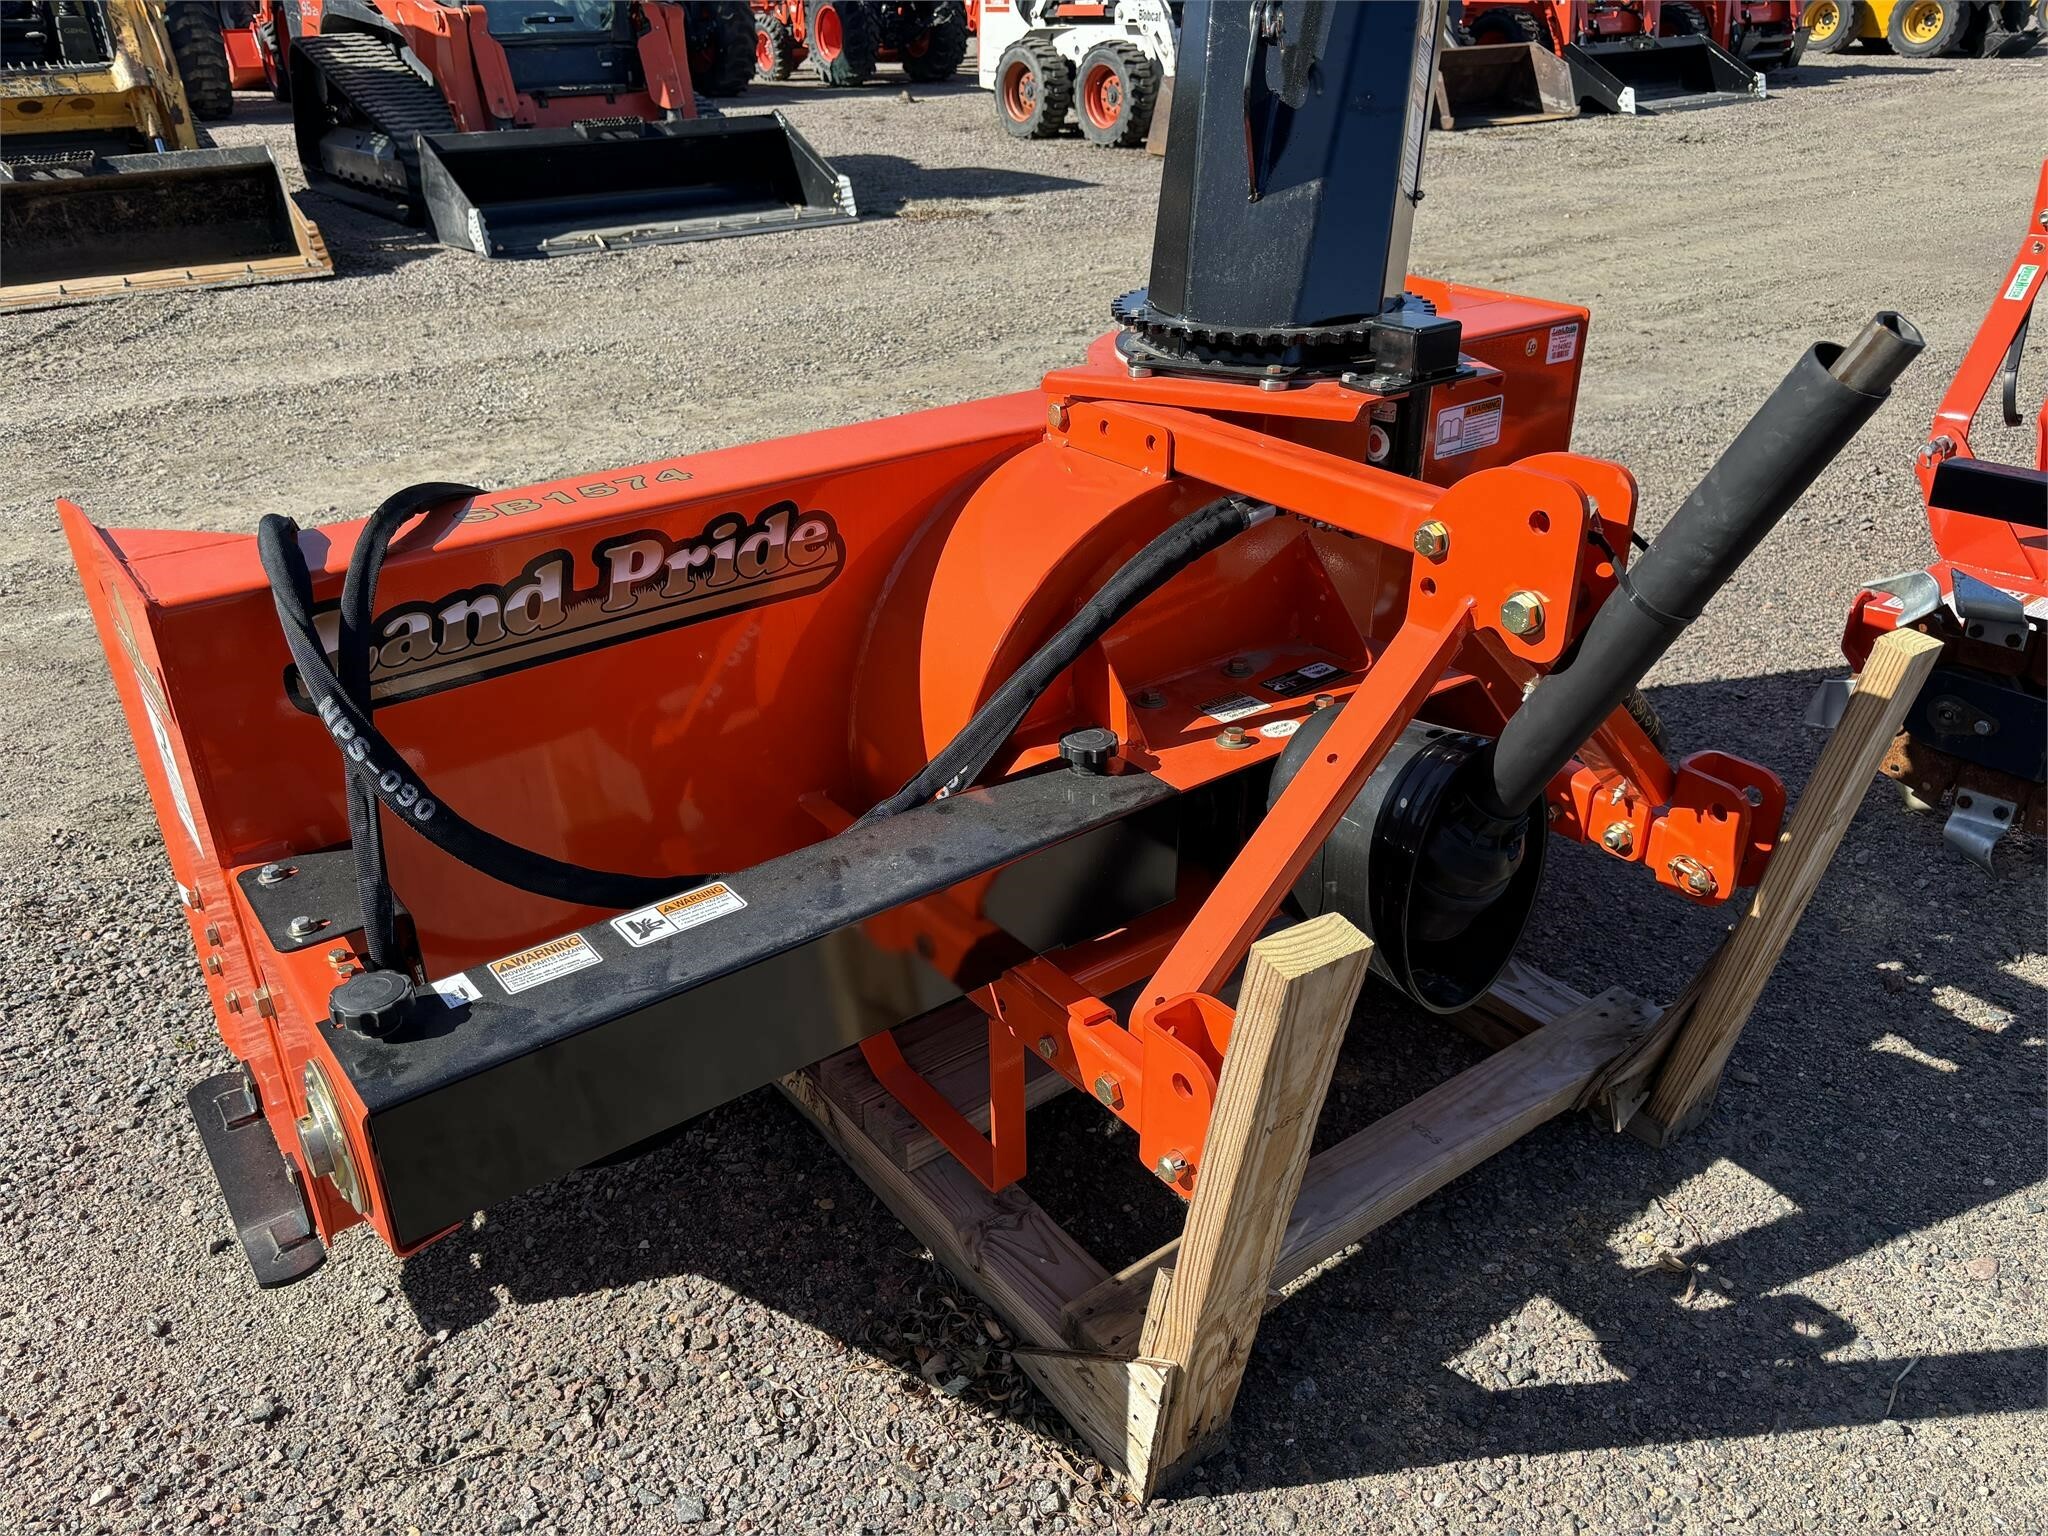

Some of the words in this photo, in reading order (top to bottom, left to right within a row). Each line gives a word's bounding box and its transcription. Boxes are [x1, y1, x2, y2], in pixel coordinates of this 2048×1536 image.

[1139, 9, 1161, 21] Bobcat
[453, 468, 693, 524] SB1574
[601, 510, 829, 613] Pride
[673, 886, 724, 907] WARNING
[501, 964, 532, 978] MOVING
[533, 956, 556, 968] PARTS
[558, 945, 587, 958] HAZARD
[510, 937, 581, 966] WARNING
